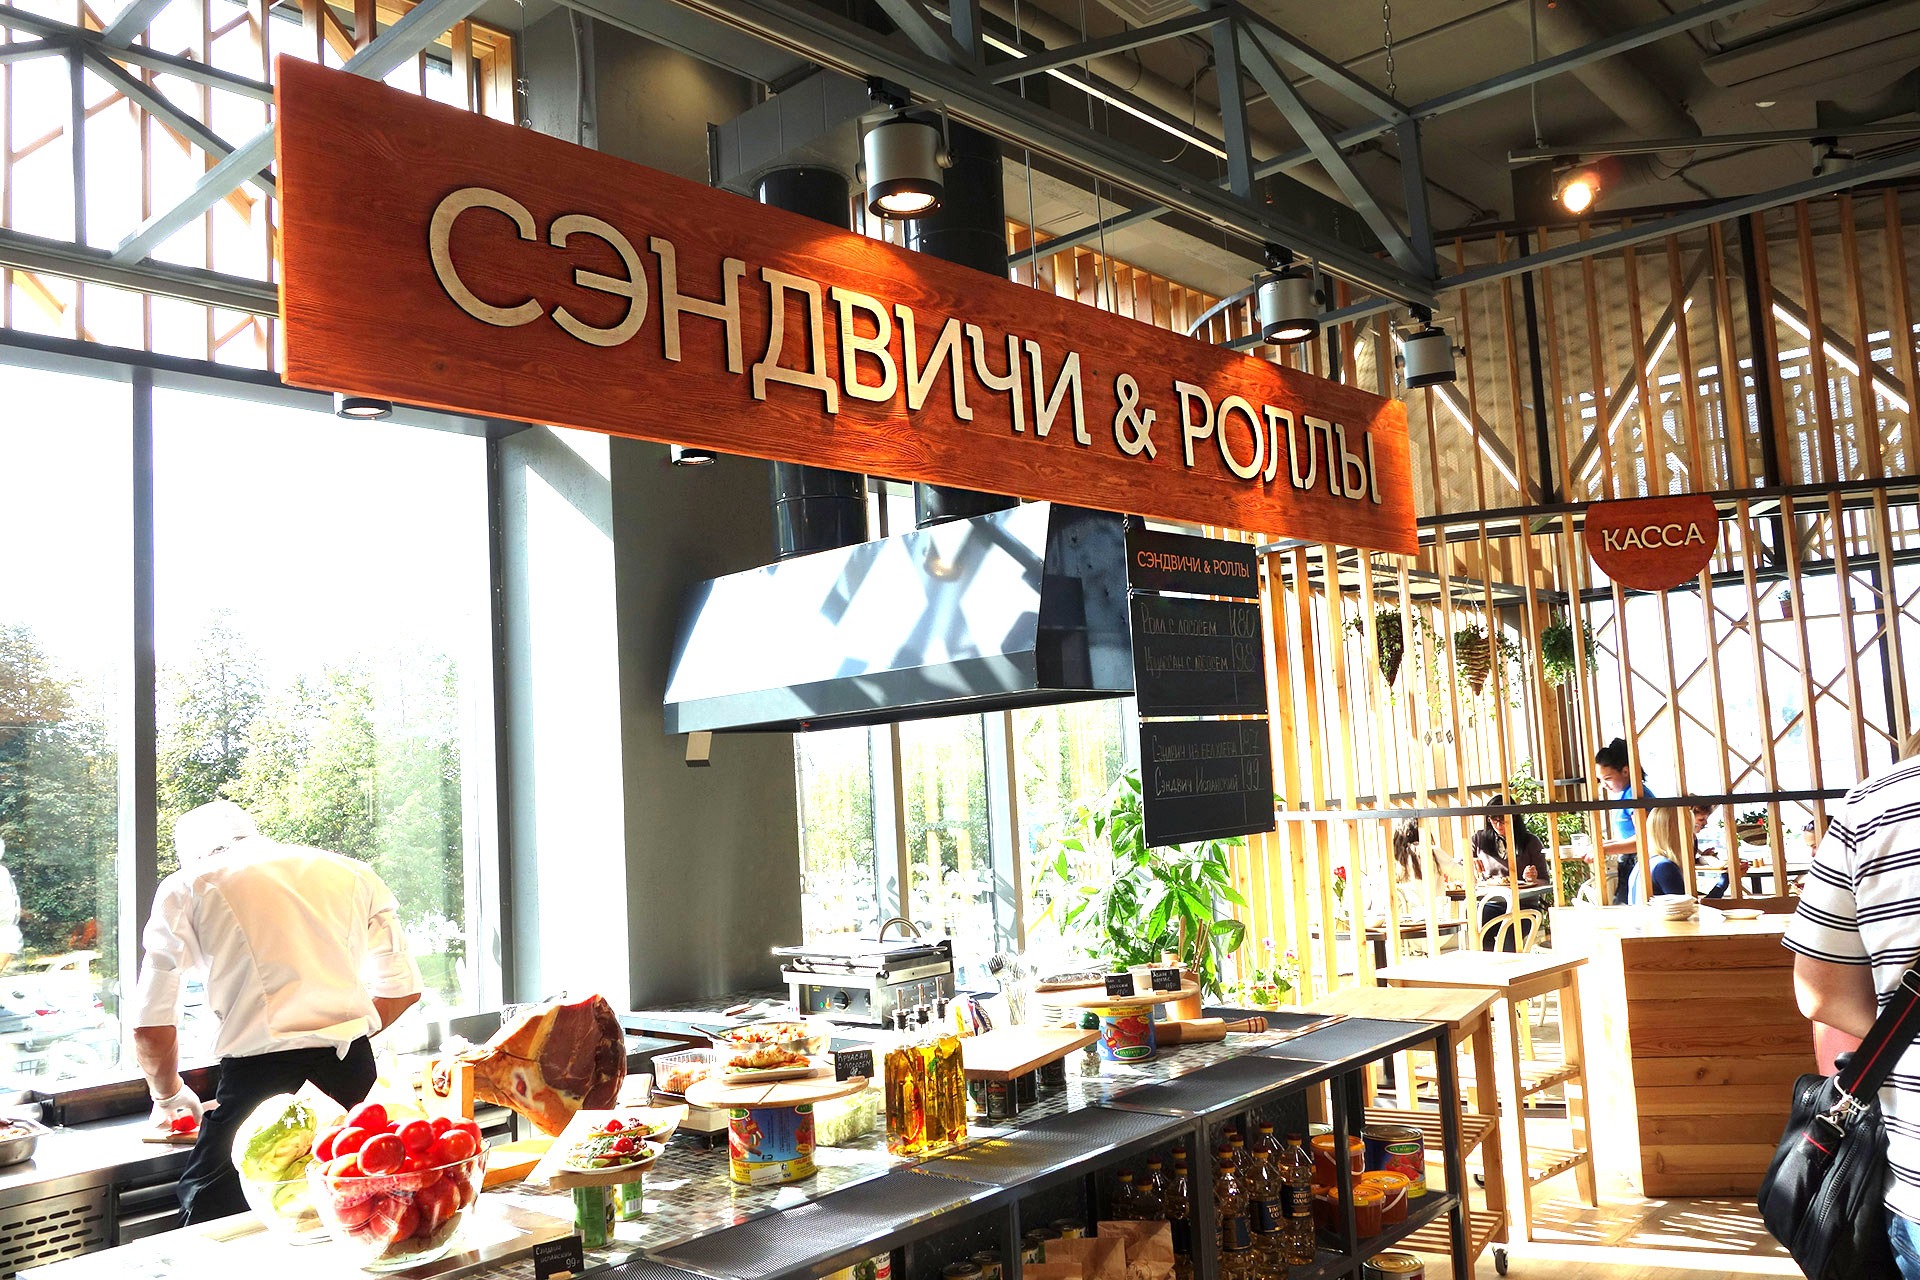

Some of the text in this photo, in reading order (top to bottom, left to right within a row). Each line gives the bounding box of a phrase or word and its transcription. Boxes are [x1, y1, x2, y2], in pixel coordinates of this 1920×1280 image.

[429, 187, 1382, 504] СЭНДВИЧИ & РОЛЛЫ
[1602, 522, 1705, 551] КАССА
[1137, 550, 1250, 578] СЭНДВИЧИ & РОЛЛЫ
